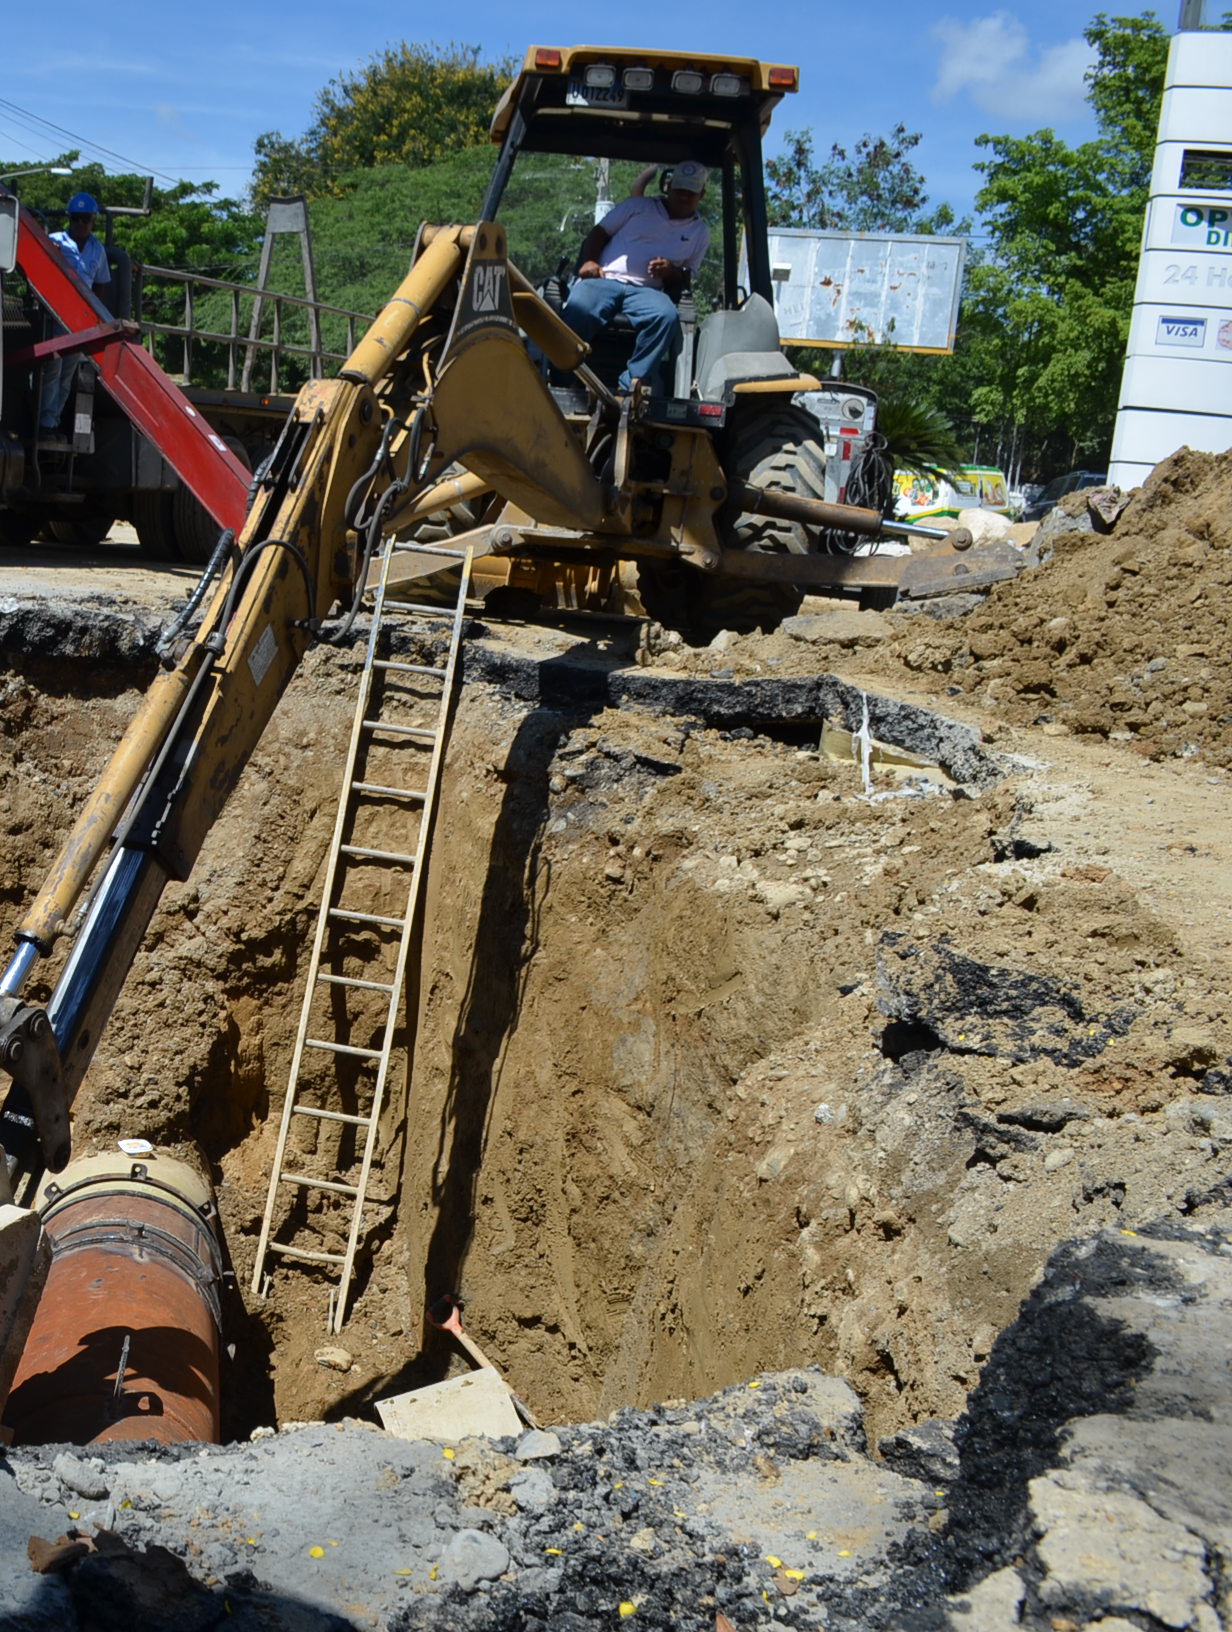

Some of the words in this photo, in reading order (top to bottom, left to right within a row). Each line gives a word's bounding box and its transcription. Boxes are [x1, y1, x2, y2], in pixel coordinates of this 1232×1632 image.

[1180, 207, 1232, 228] OP
[1206, 230, 1232, 248] DI
[1162, 264, 1198, 286] 24
[472, 265, 506, 312] CAT
[1166, 325, 1199, 338] VISA
